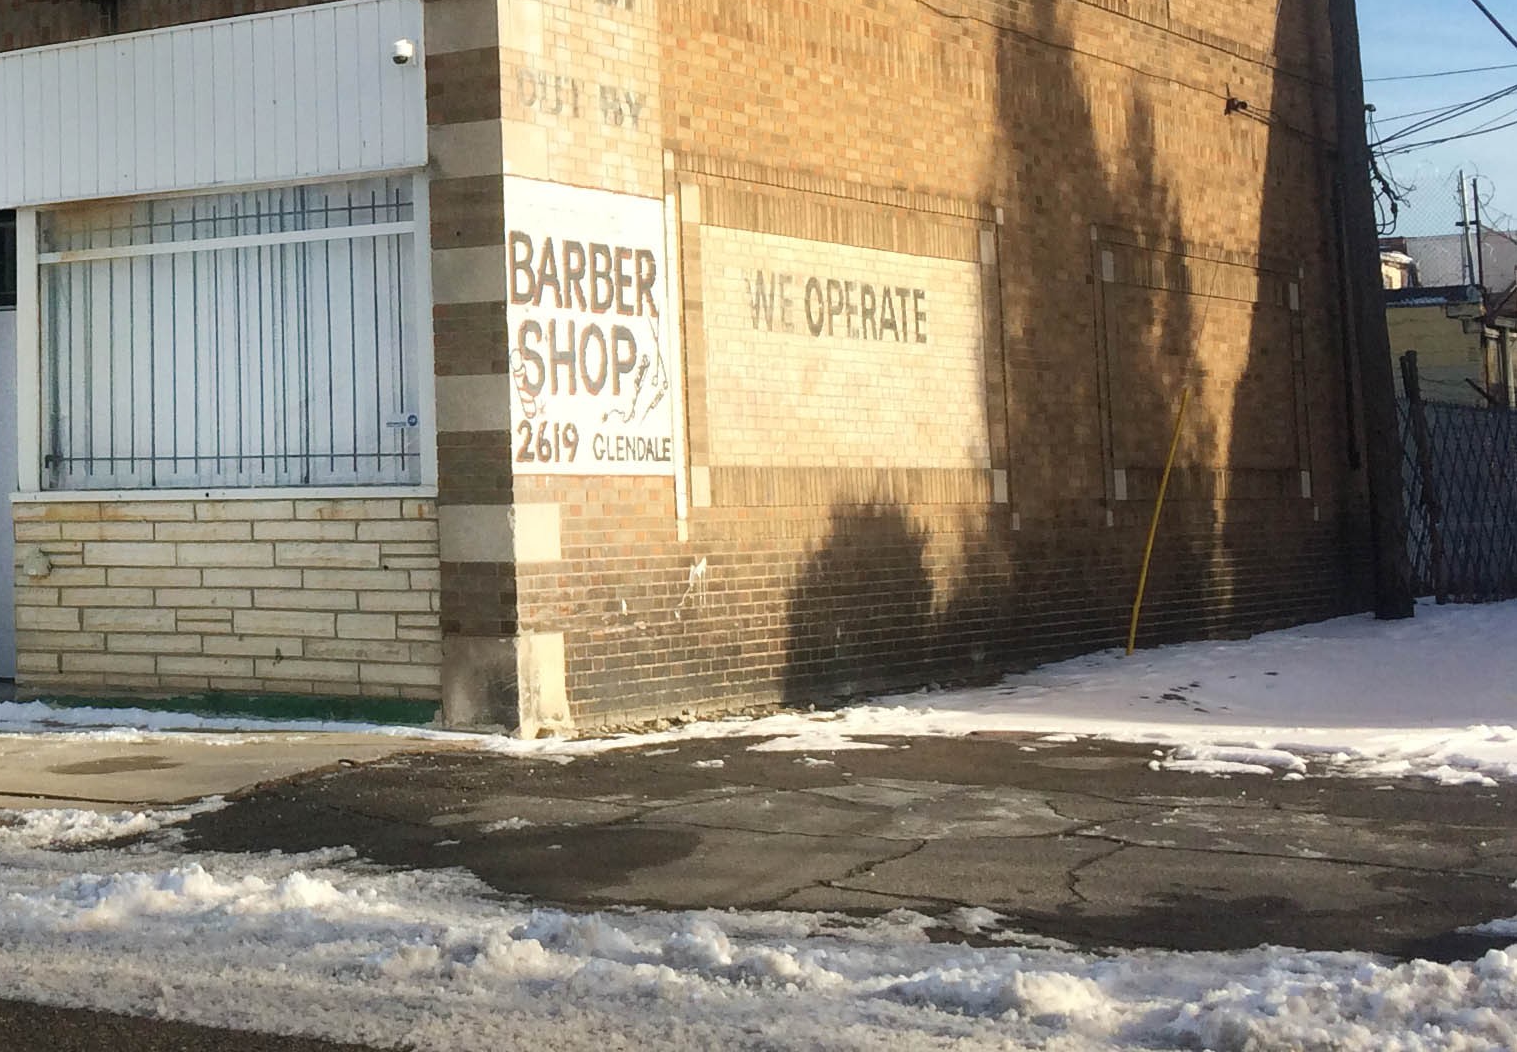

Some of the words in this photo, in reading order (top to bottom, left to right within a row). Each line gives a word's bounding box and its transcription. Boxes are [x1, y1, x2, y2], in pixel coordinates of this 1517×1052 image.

[508, 230, 659, 317] BARBER
[744, 269, 794, 332] WE
[804, 276, 927, 344] OPERATE
[518, 319, 637, 397] SHOP
[515, 419, 579, 463] 2619
[593, 433, 671, 462] GLENDALE
